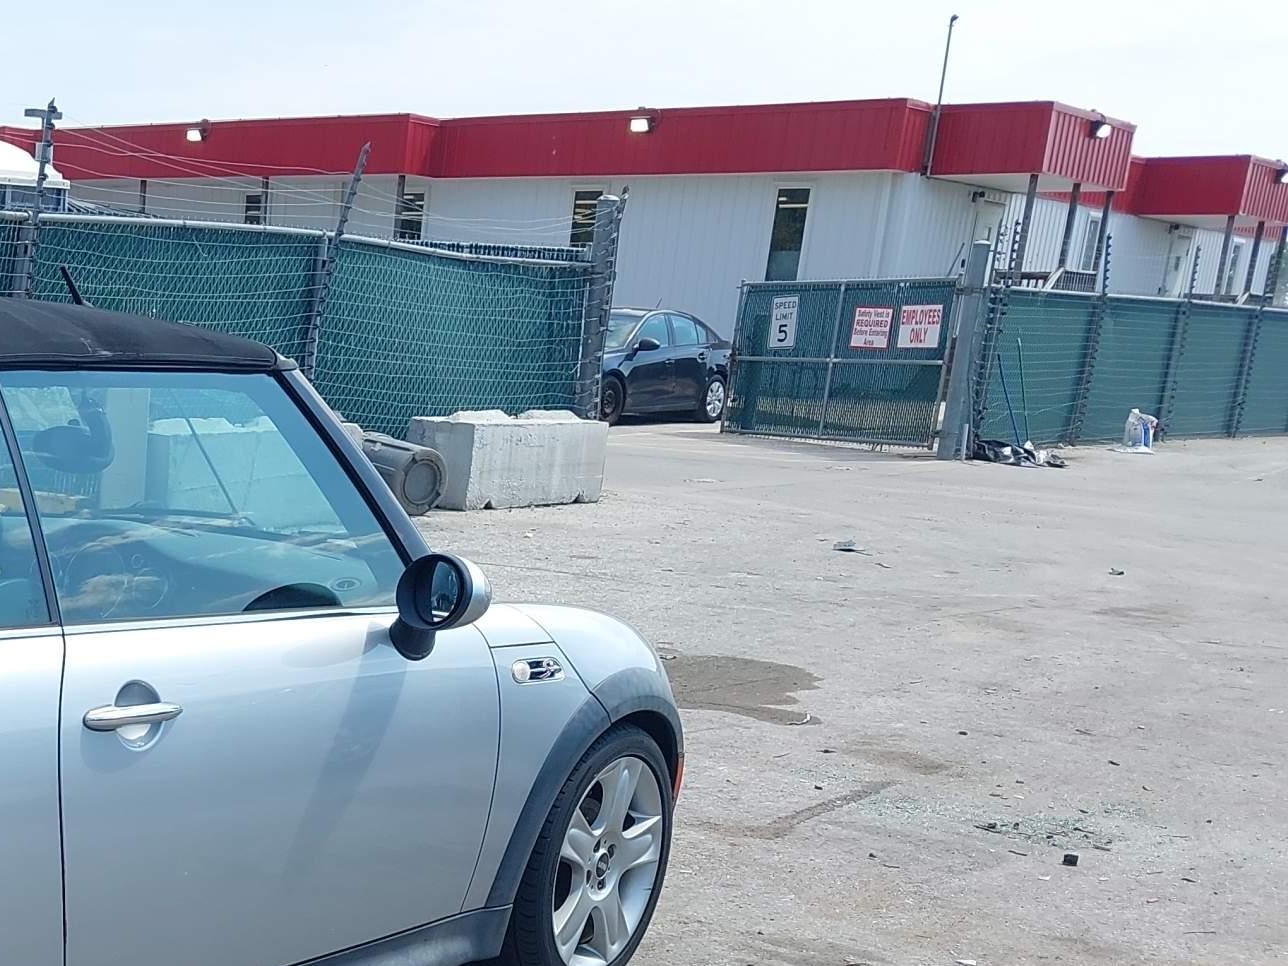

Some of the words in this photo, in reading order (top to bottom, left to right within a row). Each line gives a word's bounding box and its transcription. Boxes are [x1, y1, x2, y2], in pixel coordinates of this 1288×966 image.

[774, 301, 797, 310] SPEED
[775, 312, 794, 321] LIMIT
[902, 309, 941, 326] EMPLOYEES
[855, 319, 889, 328] REQUIRED
[776, 324, 788, 343] 5
[909, 327, 928, 344] ONLY
